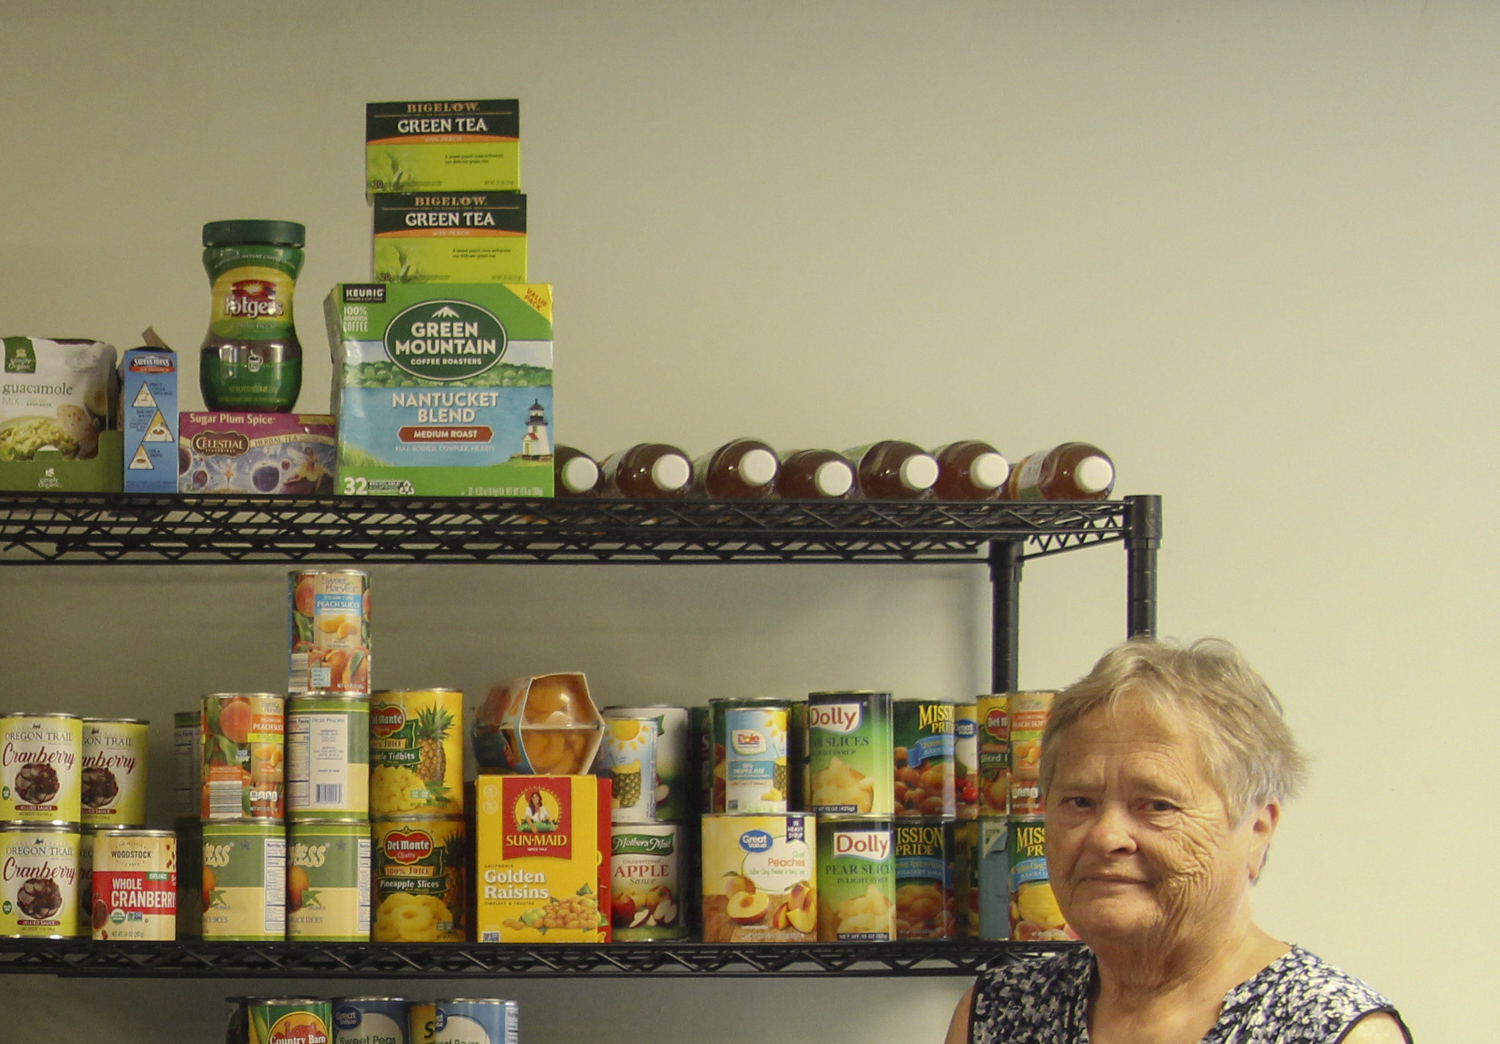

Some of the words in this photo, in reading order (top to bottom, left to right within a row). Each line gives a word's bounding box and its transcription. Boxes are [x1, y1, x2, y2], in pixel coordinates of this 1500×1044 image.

[408, 103, 479, 113] BIGELOW
[398, 119, 451, 133] GREEN
[456, 118, 487, 131] TEA
[415, 197, 487, 206] BIGELOW
[405, 213, 459, 227] GREEN
[463, 213, 495, 225] TEA
[346, 289, 383, 297] KEURIG
[526, 288, 548, 307] VALUE
[524, 295, 542, 311] PACK
[344, 307, 367, 315] 100%
[343, 322, 367, 332] COFFEE
[411, 323, 478, 337] GREEN
[395, 340, 496, 354] MOUNTAIN
[3, 383, 73, 396] guacamole
[392, 393, 498, 407] NANTUCKET
[190, 414, 217, 425] Sugar
[220, 414, 244, 423] Plum
[247, 414, 273, 425] Spice
[418, 409, 476, 423] BLEND
[451, 430, 477, 438] ROAST
[196, 436, 244, 449] CELESTIAL
[344, 477, 367, 494] 32
[811, 708, 857, 731] Dolly
[5, 732, 42, 741] OREGON
[46, 732, 72, 741] TRAIL
[3, 742, 75, 770] Cranberry
[387, 841, 399, 850] Del
[400, 841, 429, 850] Monte
[742, 835, 766, 845] Great
[836, 835, 888, 857] Dolly
[111, 851, 151, 859] WOODSTOCK
[768, 858, 805, 867] Peaches
[484, 870, 545, 883] Golden
[615, 865, 668, 878] APPLE
[113, 879, 142, 889] WHOLE
[380, 880, 414, 889] Pineapple
[418, 880, 439, 888] Slices
[629, 876, 655, 885] Sauce
[484, 885, 549, 899] Raisins
[309, 1034, 327, 1044] Barn
